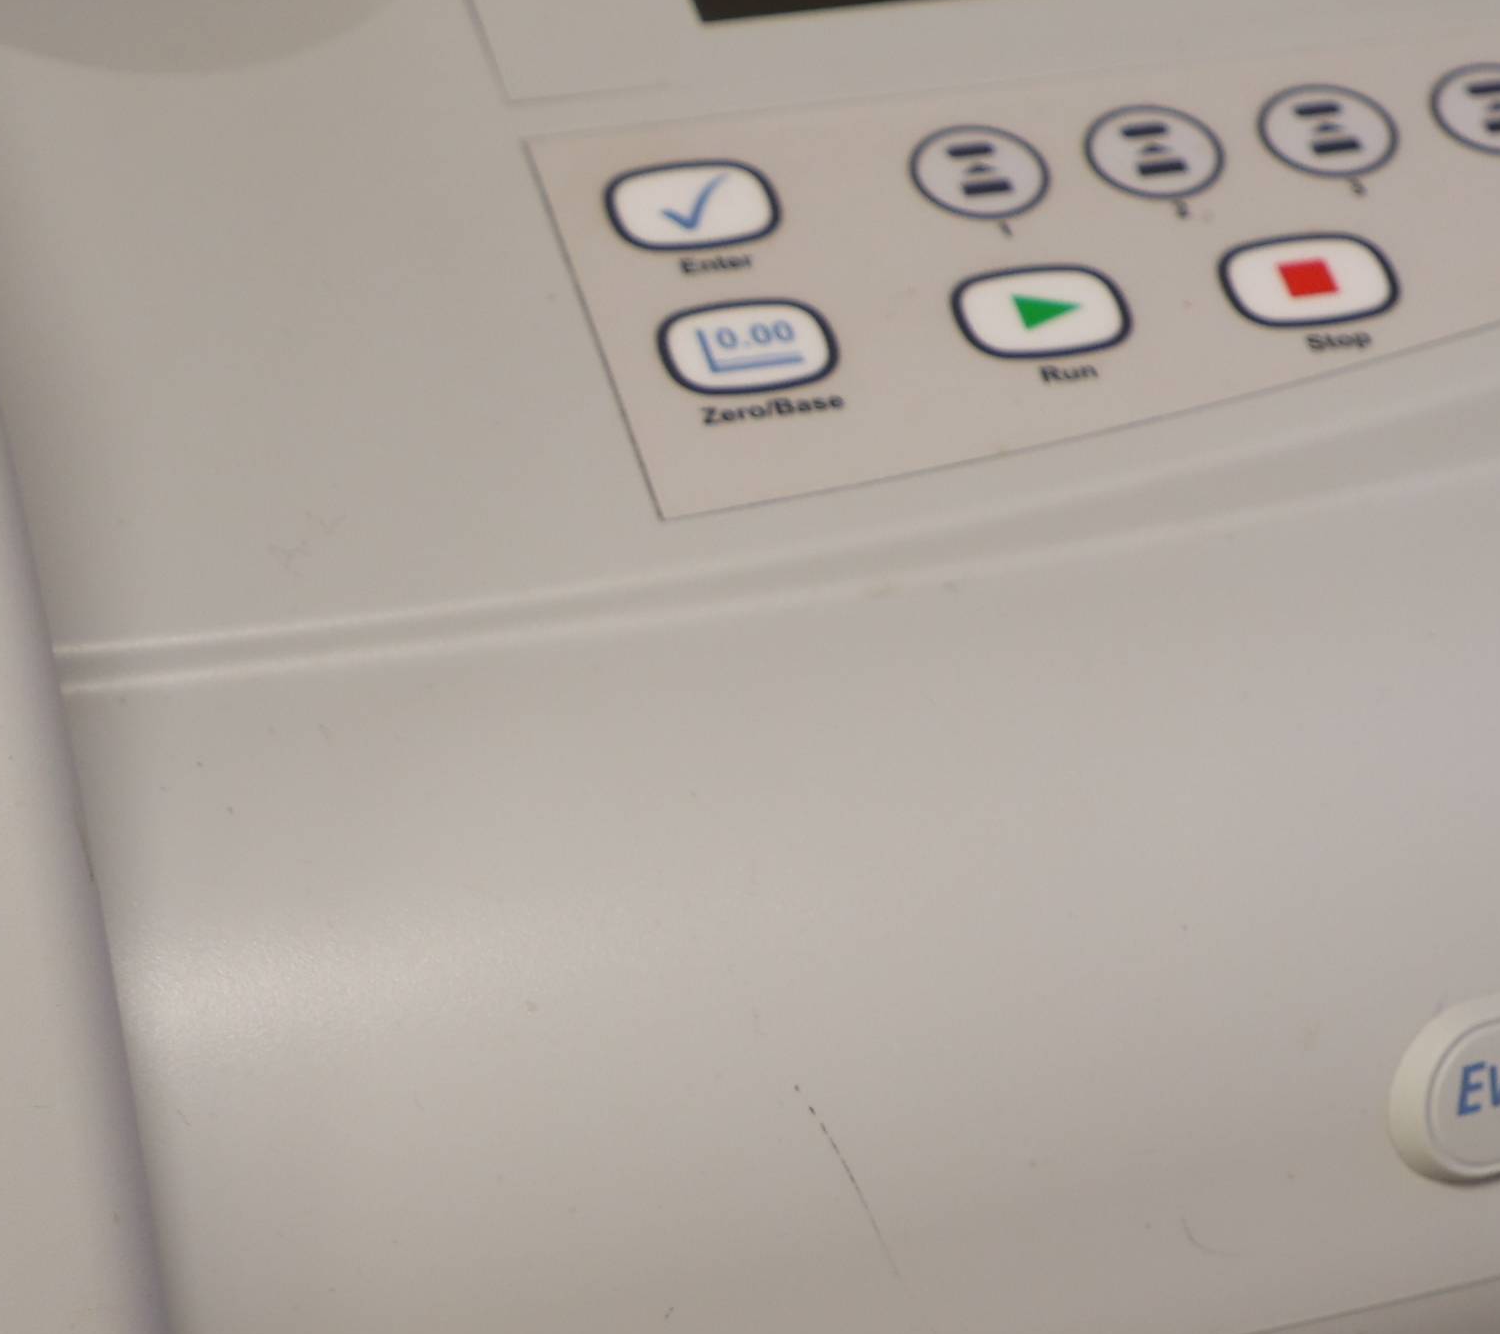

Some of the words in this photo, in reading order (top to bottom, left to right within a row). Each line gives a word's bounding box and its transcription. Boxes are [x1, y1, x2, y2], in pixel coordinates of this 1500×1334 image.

[679, 254, 753, 275] Enter
[715, 320, 796, 350] 0.00
[1305, 331, 1373, 352] Stop
[1038, 364, 1099, 384] Run
[702, 394, 845, 426] Zero/Base
